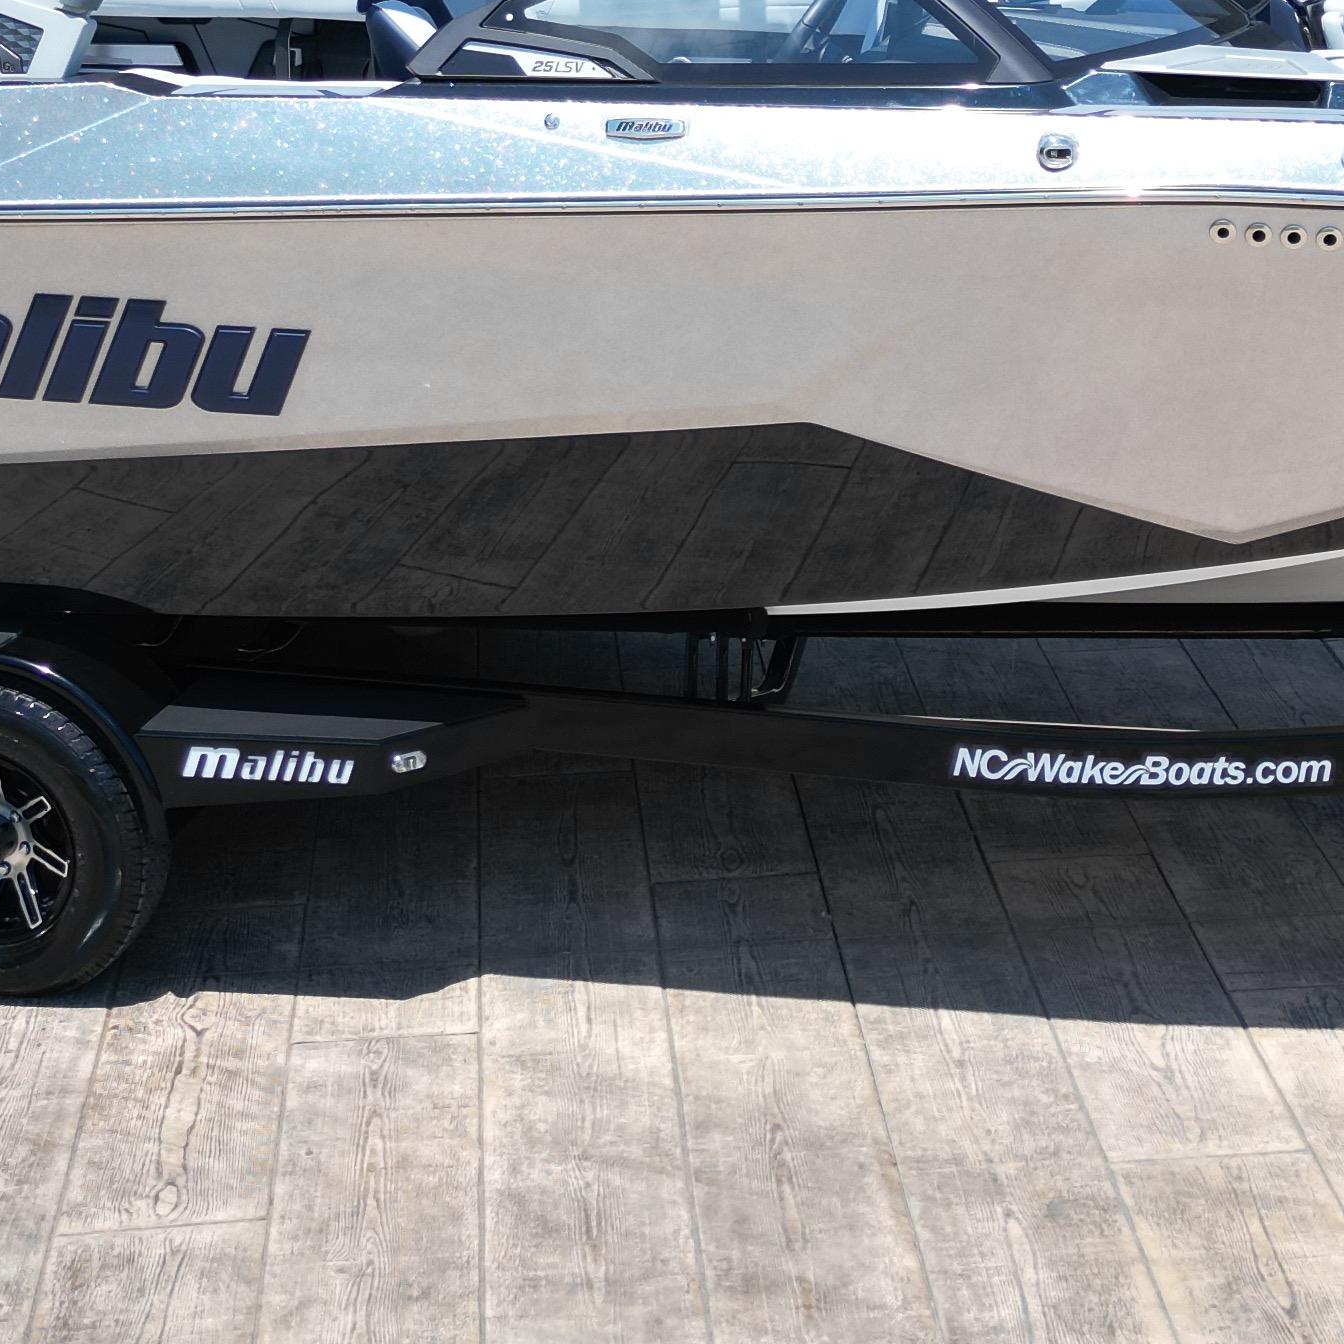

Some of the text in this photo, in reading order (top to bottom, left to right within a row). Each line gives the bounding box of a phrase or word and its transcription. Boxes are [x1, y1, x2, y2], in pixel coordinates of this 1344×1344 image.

[532, 60, 585, 73] 25LSV
[615, 120, 673, 133] Malibu
[182, 746, 355, 784] Malibu
